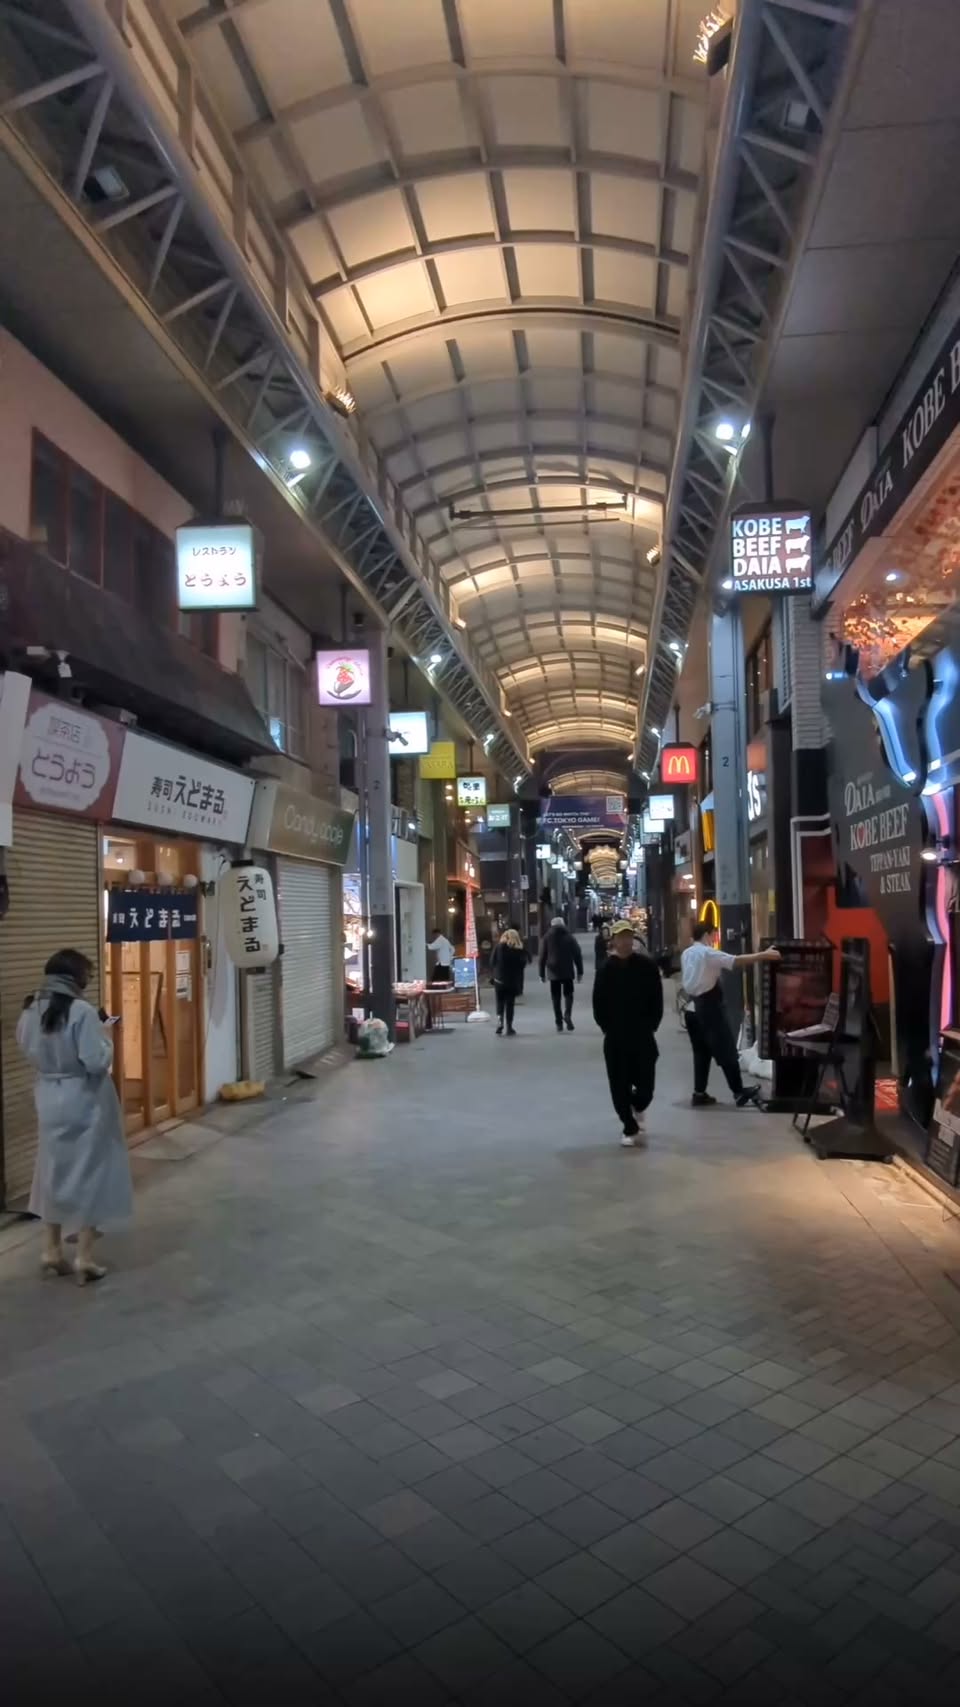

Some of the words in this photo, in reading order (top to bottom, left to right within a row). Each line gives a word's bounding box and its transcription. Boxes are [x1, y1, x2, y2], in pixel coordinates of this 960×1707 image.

[902, 367, 946, 469] KOBE
[733, 518, 782, 537] KOBE
[733, 536, 781, 557] BEEF
[733, 556, 782, 577] DAIA
[185, 573, 246, 587] とうよう
[734, 577, 790, 591] ASAKUSA
[793, 576, 812, 588] 1st
[32, 747, 96, 789] とうよう
[722, 757, 729, 767] 2
[151, 776, 173, 801] 寿司
[173, 774, 225, 815] えどまる
[850, 816, 879, 851] KOBE
[879, 803, 909, 842] BEEF
[255, 874, 267, 901] 寿司
[886, 872, 911, 892] STEAK
[129, 907, 181, 929] えどまる
[236, 875, 261, 953] えどまる
